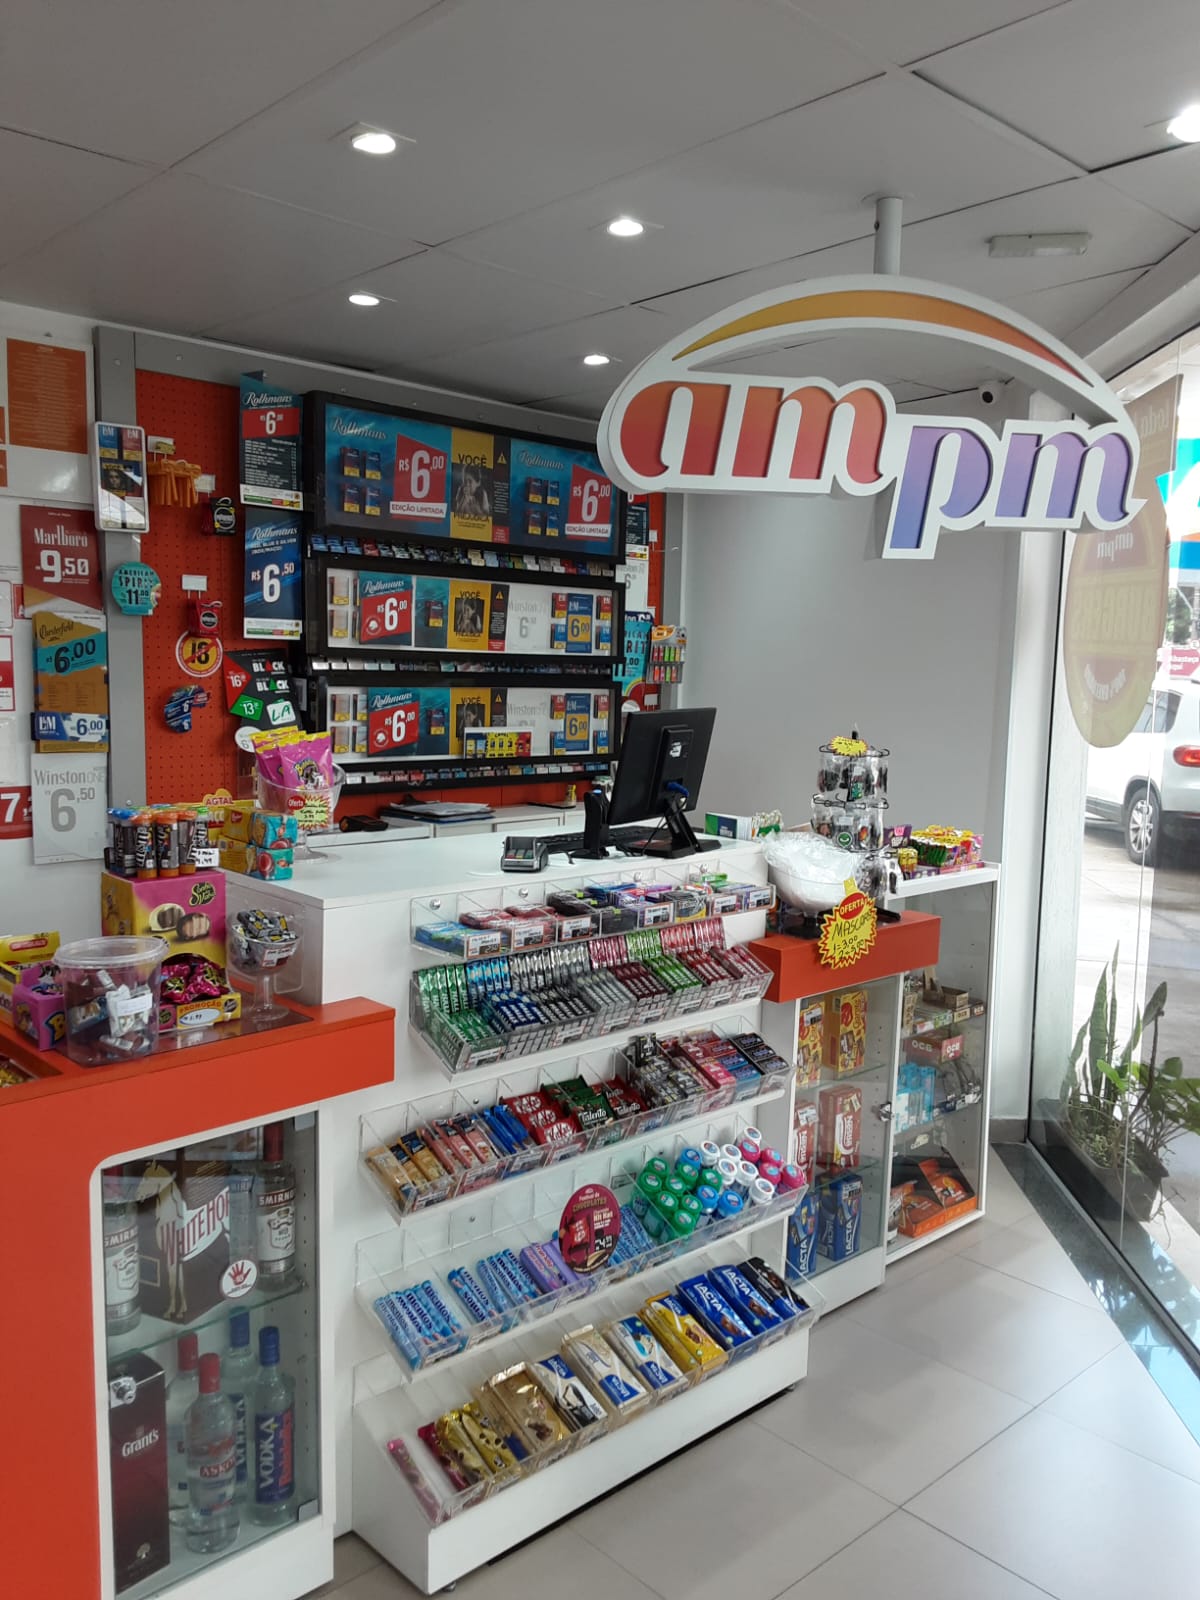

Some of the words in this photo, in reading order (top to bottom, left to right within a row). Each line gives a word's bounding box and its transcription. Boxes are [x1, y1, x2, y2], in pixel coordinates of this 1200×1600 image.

[244, 392, 293, 406] Rothmans
[331, 416, 387, 441] Rothmans
[458, 452, 488, 467] VOCÊ
[519, 450, 564, 471] Rothmans
[399, 458, 410, 473] R$
[410, 450, 444, 499] 6,00
[391, 503, 414, 515] EDIÇÃO
[416, 505, 445, 516] LIMITADA
[573, 486, 582, 498] R$
[582, 479, 610, 522] 6,00
[34, 525, 88, 548] Marlboro
[252, 526, 298, 540] Rothmans
[565, 525, 586, 535] EDIÇÃO
[587, 526, 611, 536] LIMITADA
[40, 549, 90, 584] 9,50
[251, 570, 260, 582] R$
[263, 562, 295, 603] 6,50
[364, 580, 405, 594] Rothmans
[384, 597, 407, 631] 6,00
[38, 621, 75, 640] Chesterfield
[371, 692, 413, 708] Rothmans
[392, 709, 416, 743] 6,00
[33, 769, 86, 787] Winston
[50, 787, 96, 833] 6,50
[288, 799, 304, 807] Oferta
[840, 897, 865, 915] OFERTA
[179, 1001, 222, 1014] PROMOÇÃO
[912, 1040, 933, 1052] OCB
[946, 1042, 960, 1053] OCB
[578, 1109, 607, 1123] Talento
[613, 1103, 641, 1116] Talento
[160, 1212, 205, 1266] WHITE
[496, 1257, 523, 1292] mentos
[722, 1268, 750, 1296] LACTA
[463, 1271, 489, 1307] mentos
[694, 1282, 722, 1312] LACTA
[406, 1291, 434, 1331] mentos
[425, 1285, 452, 1324] mentos
[121, 1427, 160, 1458] Grant's
[259, 1416, 275, 1490] VODKA
